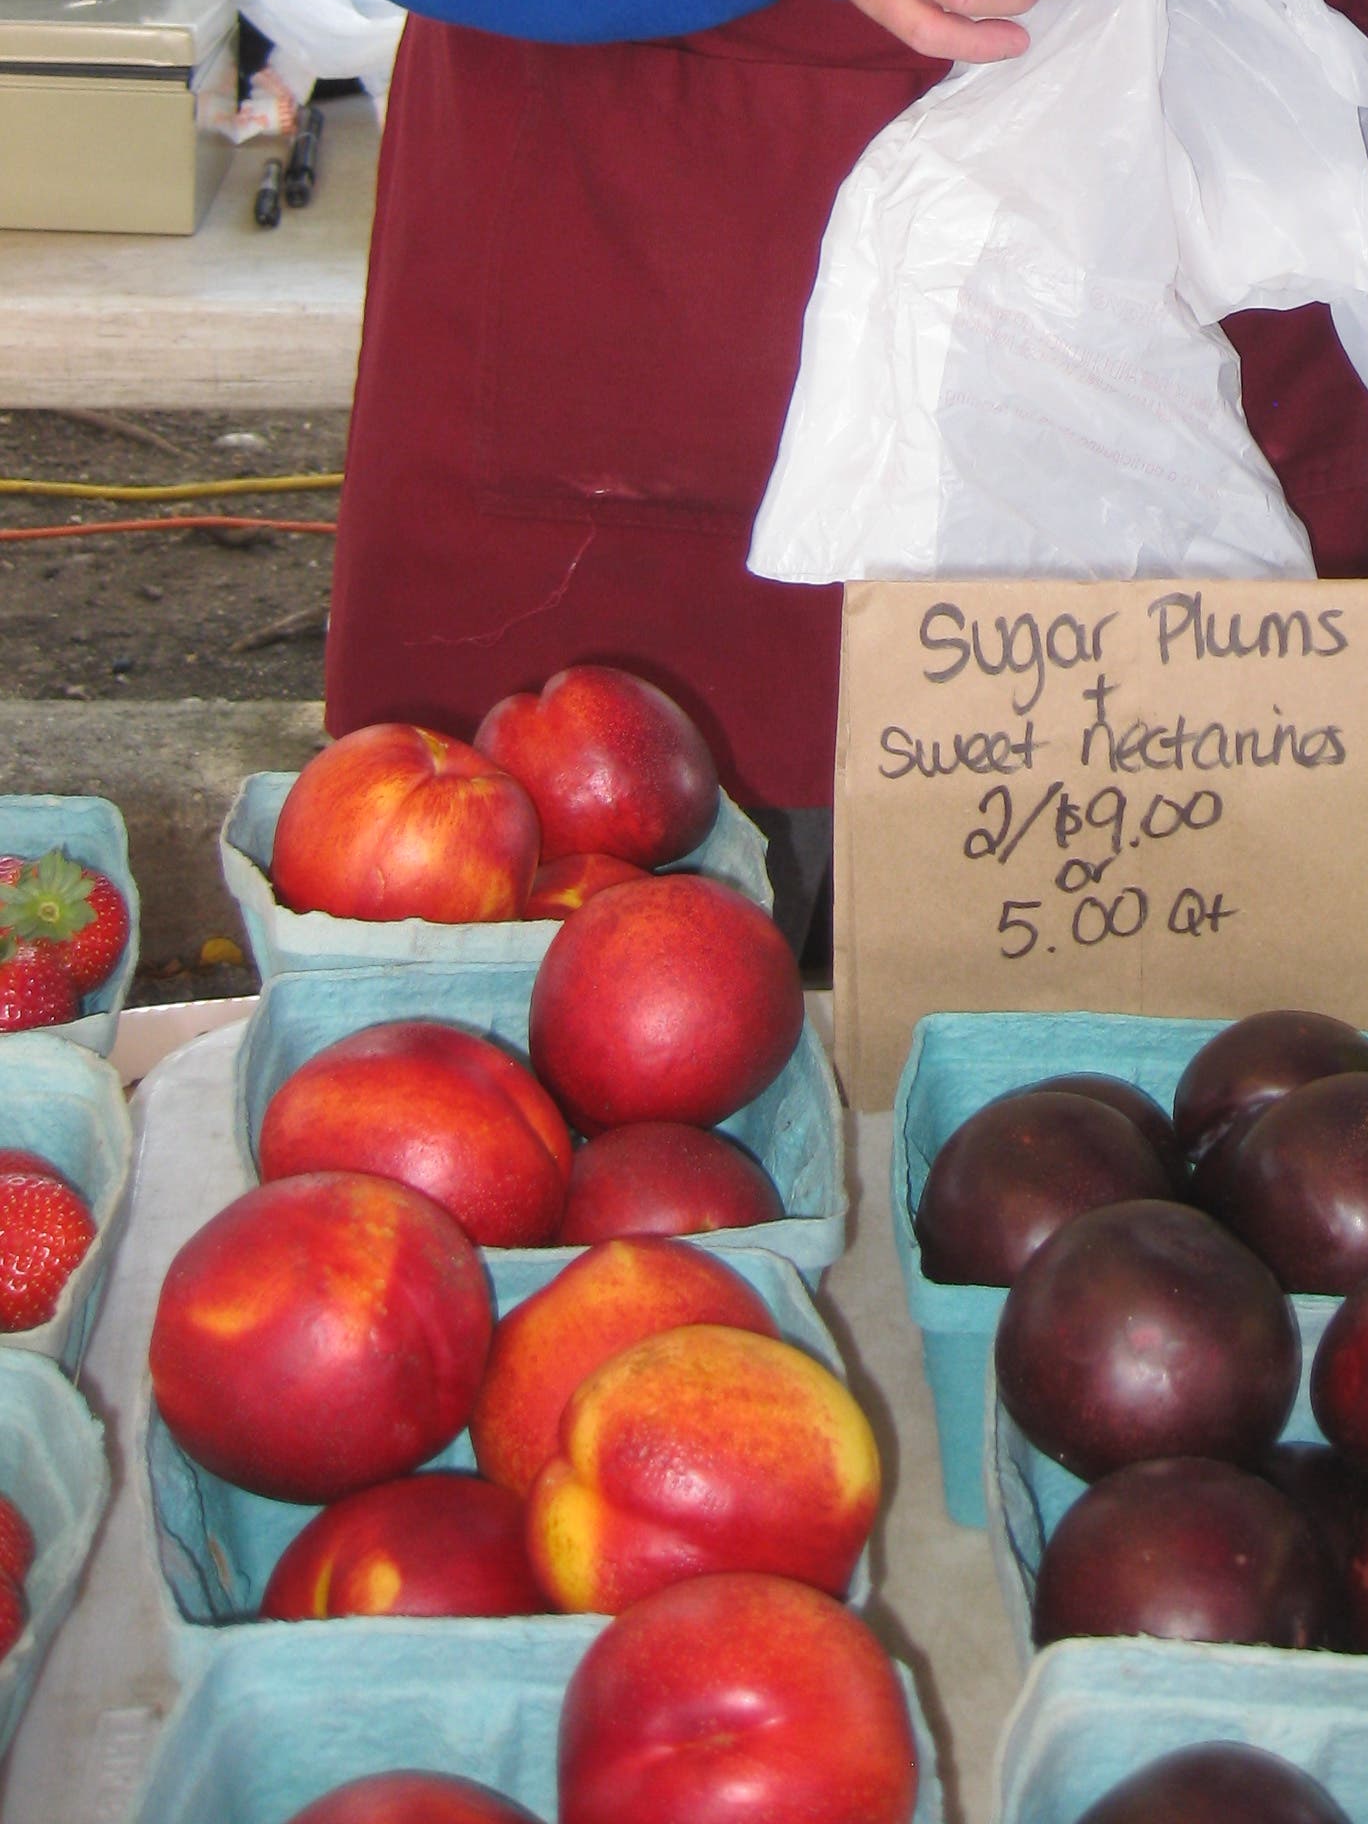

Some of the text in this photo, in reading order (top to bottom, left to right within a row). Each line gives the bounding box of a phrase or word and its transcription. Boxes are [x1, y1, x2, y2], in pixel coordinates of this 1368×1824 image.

[919, 591, 1349, 715] Sugar Plums
[1055, 855, 1118, 893] or
[998, 886, 1148, 959] 5.00
